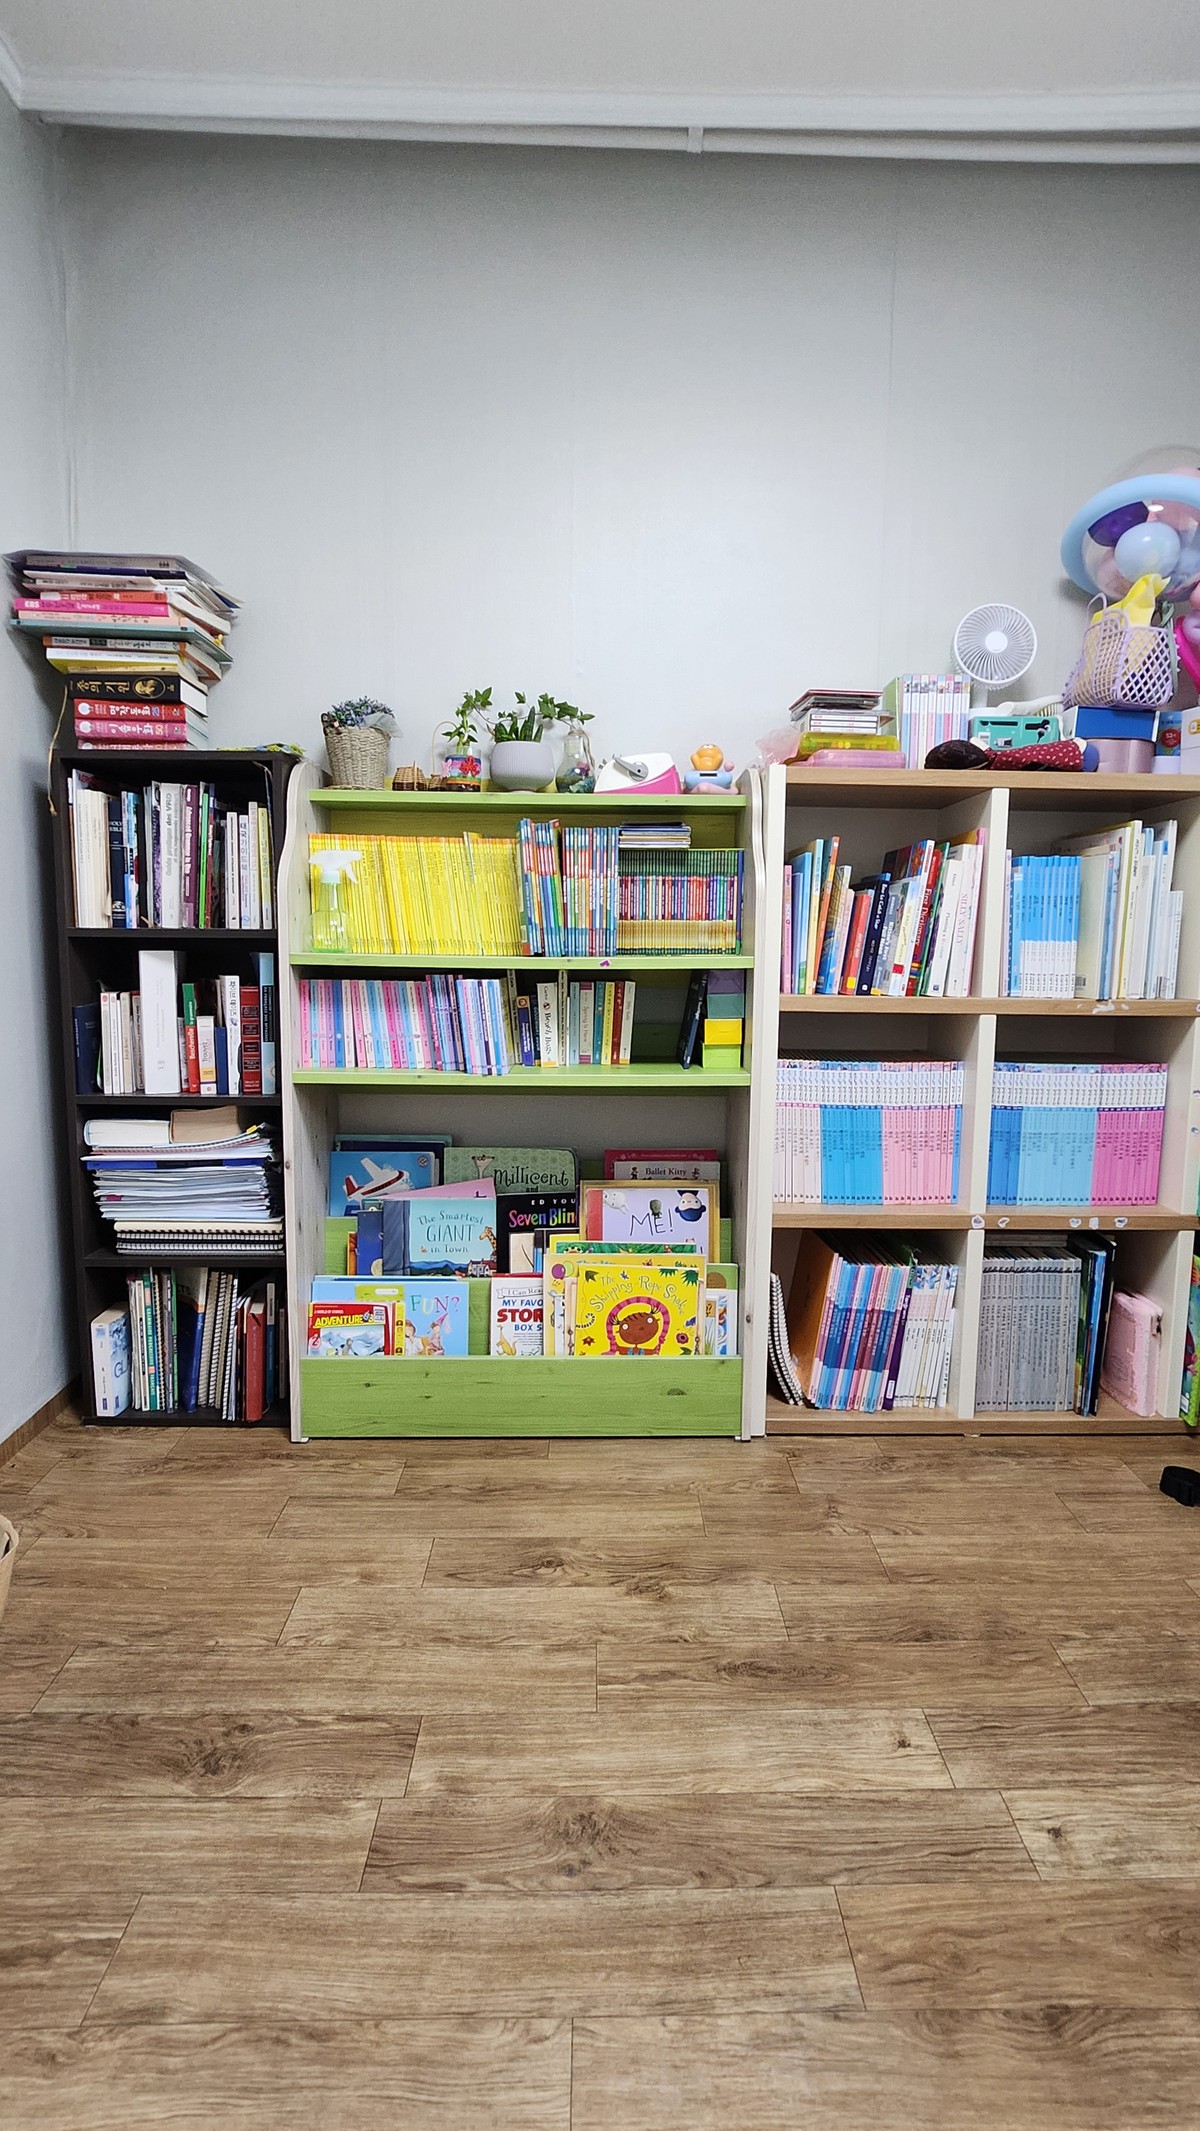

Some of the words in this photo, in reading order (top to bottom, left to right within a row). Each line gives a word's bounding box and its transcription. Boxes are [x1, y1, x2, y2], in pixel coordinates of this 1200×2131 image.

[923, 888, 933, 906] First
[959, 893, 969, 917] SILLY
[915, 907, 929, 946] Dictionary
[956, 919, 966, 945] SALLY
[582, 1006, 590, 1023] Spring
[494, 1166, 569, 1187] Millicent
[646, 1167, 666, 1175] Ballet
[669, 1167, 687, 1177] Kitty
[417, 1215, 436, 1226] The
[440, 1210, 484, 1225] Smartest
[509, 1209, 547, 1228] Seven
[549, 1207, 576, 1226] Blin
[630, 1208, 674, 1236] ME!
[426, 1224, 476, 1242] GIANT
[444, 1244, 469, 1253] Town
[600, 1271, 615, 1285] The
[589, 1281, 634, 1312] Skipping
[639, 1275, 663, 1296] Rope
[410, 1294, 459, 1314] FUN?
[502, 1299, 517, 1307] MY
[497, 1308, 543, 1323] STOR
[514, 1324, 533, 1332] BOX
